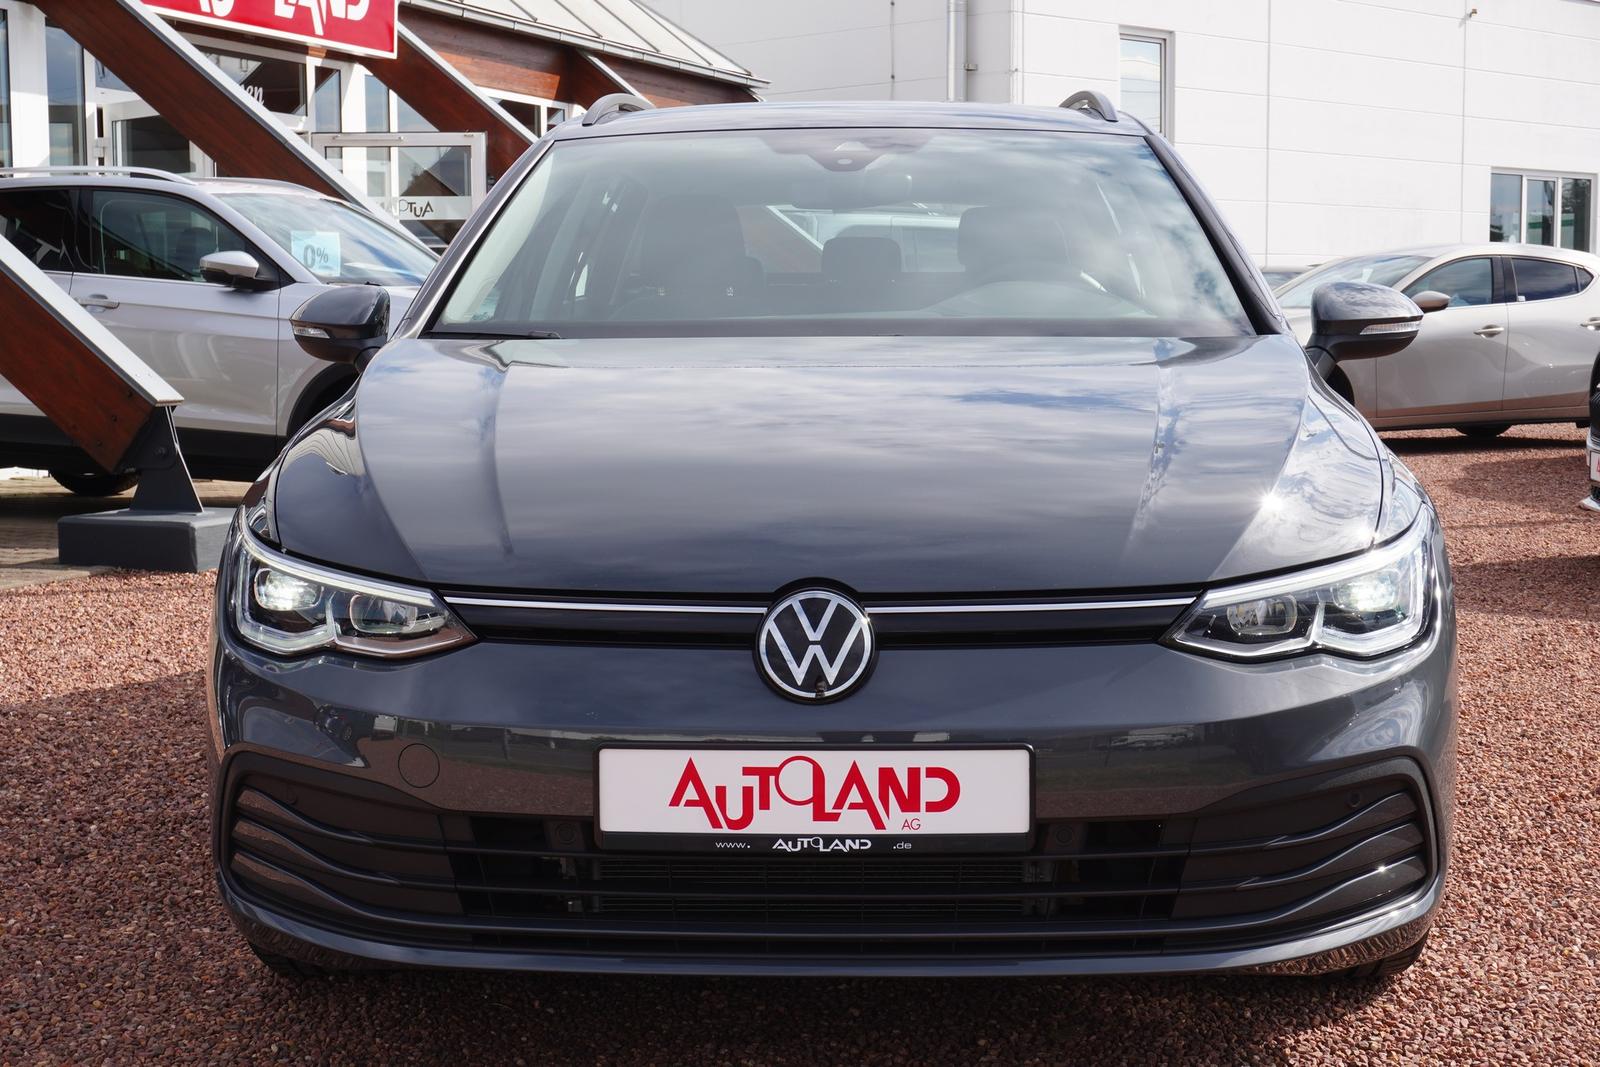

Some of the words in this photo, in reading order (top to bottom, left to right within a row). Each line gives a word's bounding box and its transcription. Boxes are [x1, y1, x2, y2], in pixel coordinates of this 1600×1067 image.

[303, 244, 329, 269] 0%
[767, 598, 864, 687] VW
[668, 755, 961, 831] AUTOLAND
[902, 817, 921, 831] AG
[715, 841, 751, 849] www.
[771, 836, 872, 852] AUTOLAND
[892, 840, 912, 850] .de
